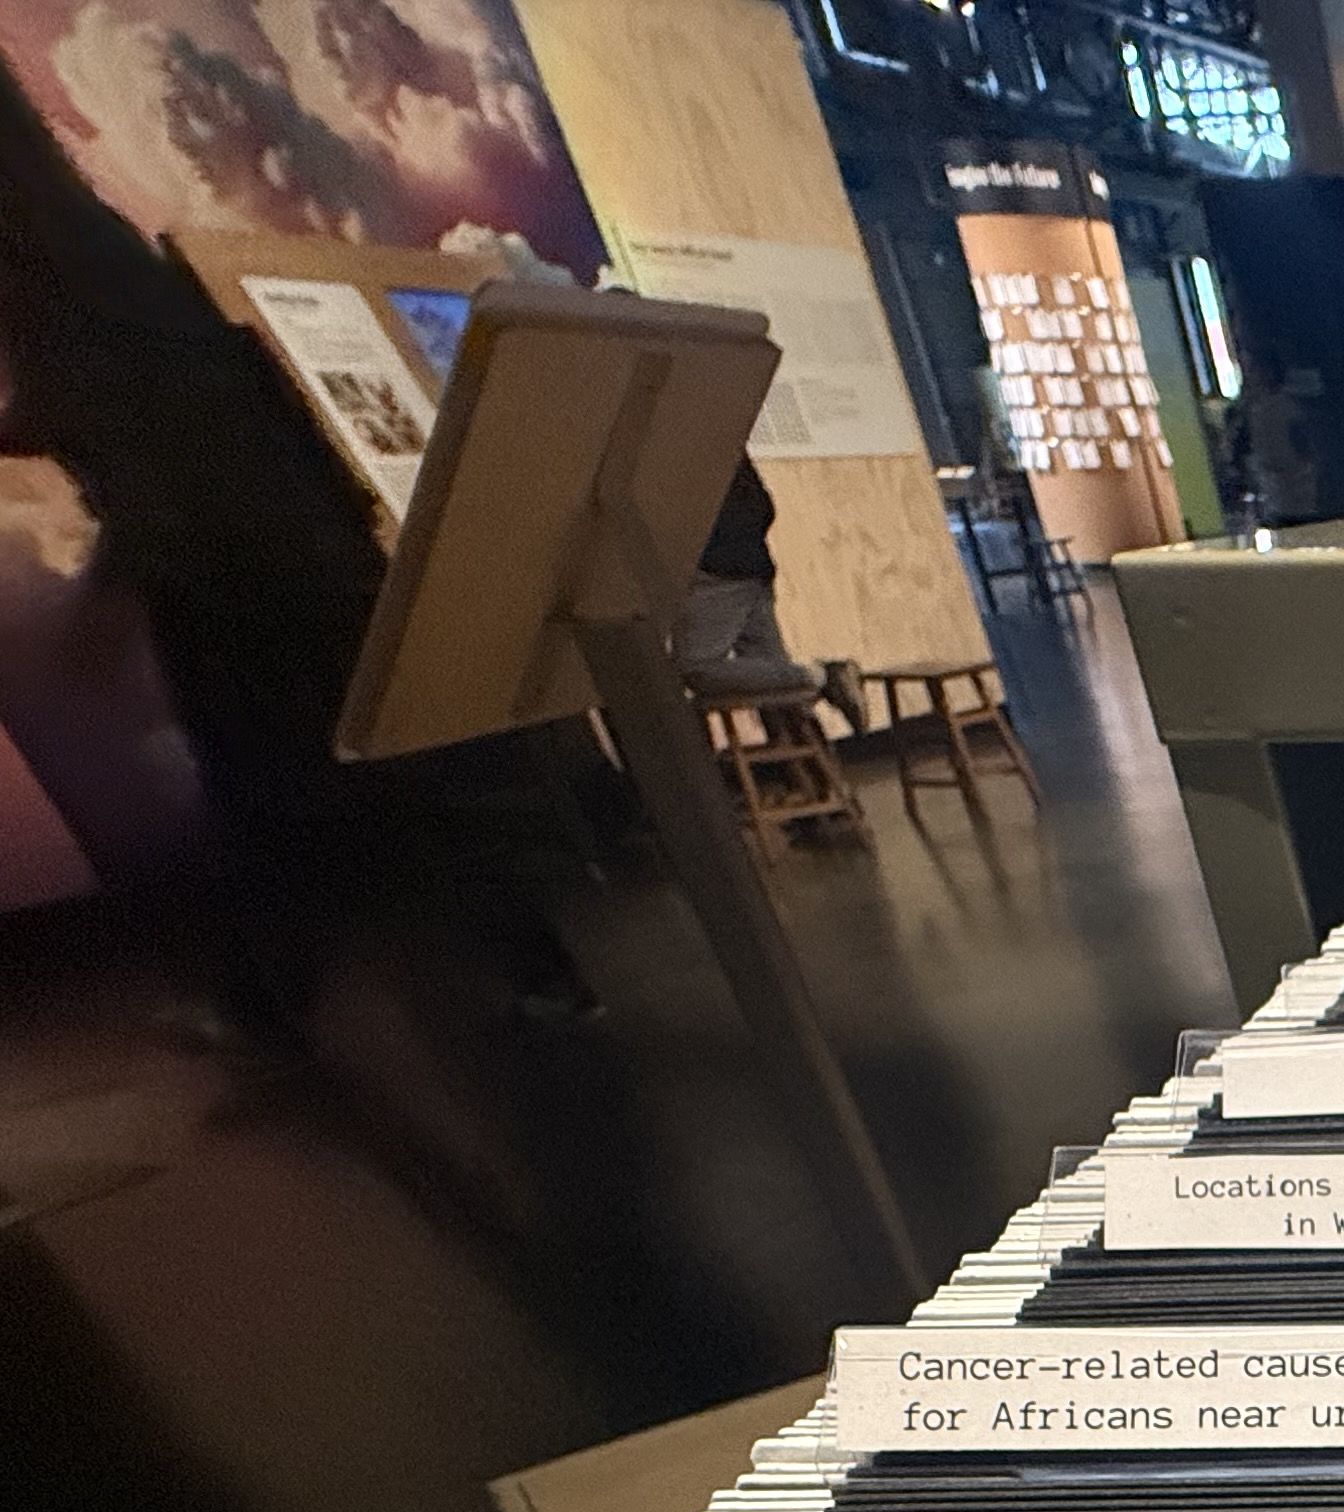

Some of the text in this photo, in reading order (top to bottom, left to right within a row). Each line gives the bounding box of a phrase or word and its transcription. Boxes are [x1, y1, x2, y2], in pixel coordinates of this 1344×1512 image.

[1175, 1174, 1331, 1198] Locations
[1285, 1213, 1315, 1236] in
[900, 1350, 1218, 1381] Cancer-related
[904, 1402, 967, 1431] for
[992, 1401, 1172, 1430] Africans
[1199, 1406, 1286, 1428] near
